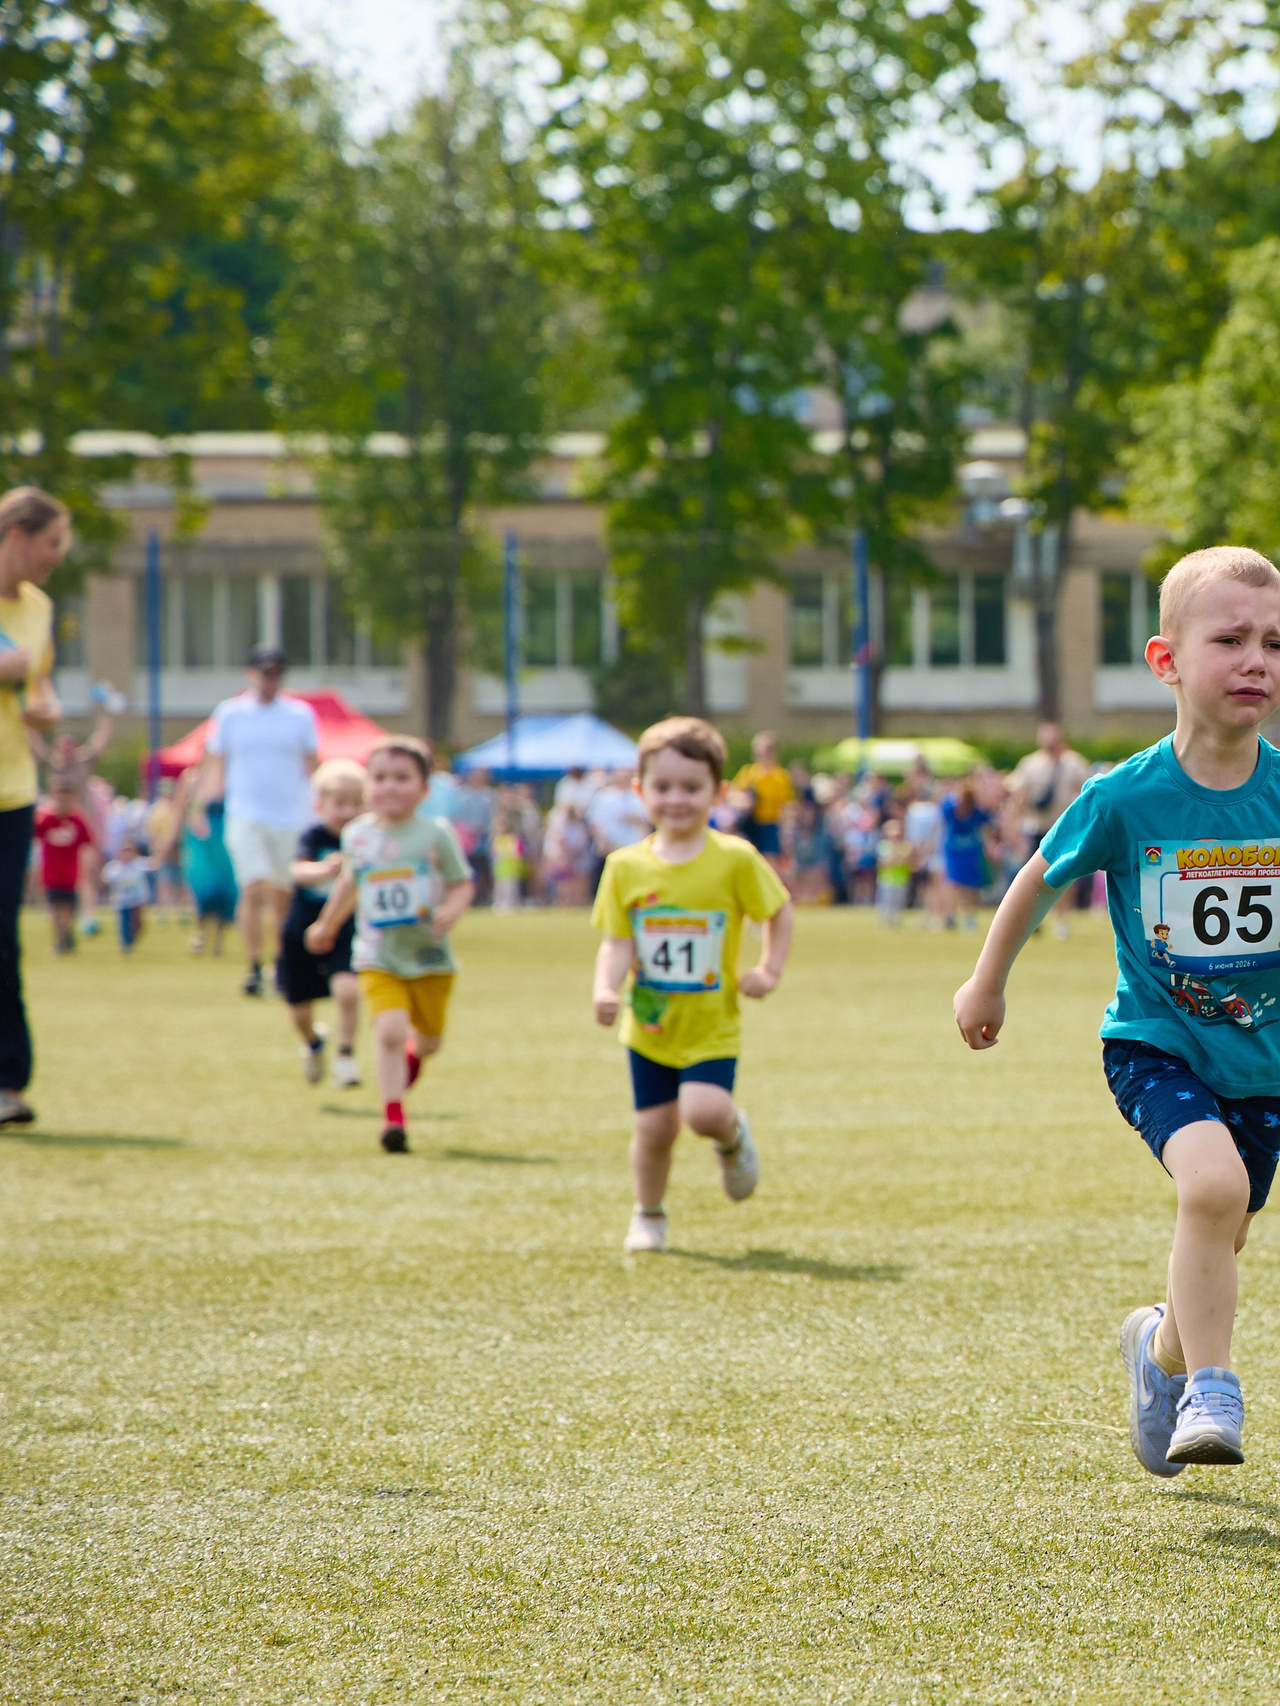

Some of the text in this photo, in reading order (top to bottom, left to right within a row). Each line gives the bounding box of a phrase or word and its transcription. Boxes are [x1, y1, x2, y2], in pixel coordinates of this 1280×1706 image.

[1186, 868, 1256, 879] ЛЕГКОАТЛЕТИЧЕСКИЙ
[374, 883, 410, 911] 40
[1193, 885, 1273, 945] 65
[652, 939, 694, 974] 41
[1208, 963, 1214, 971] 6
[1235, 960, 1251, 969] 2026
